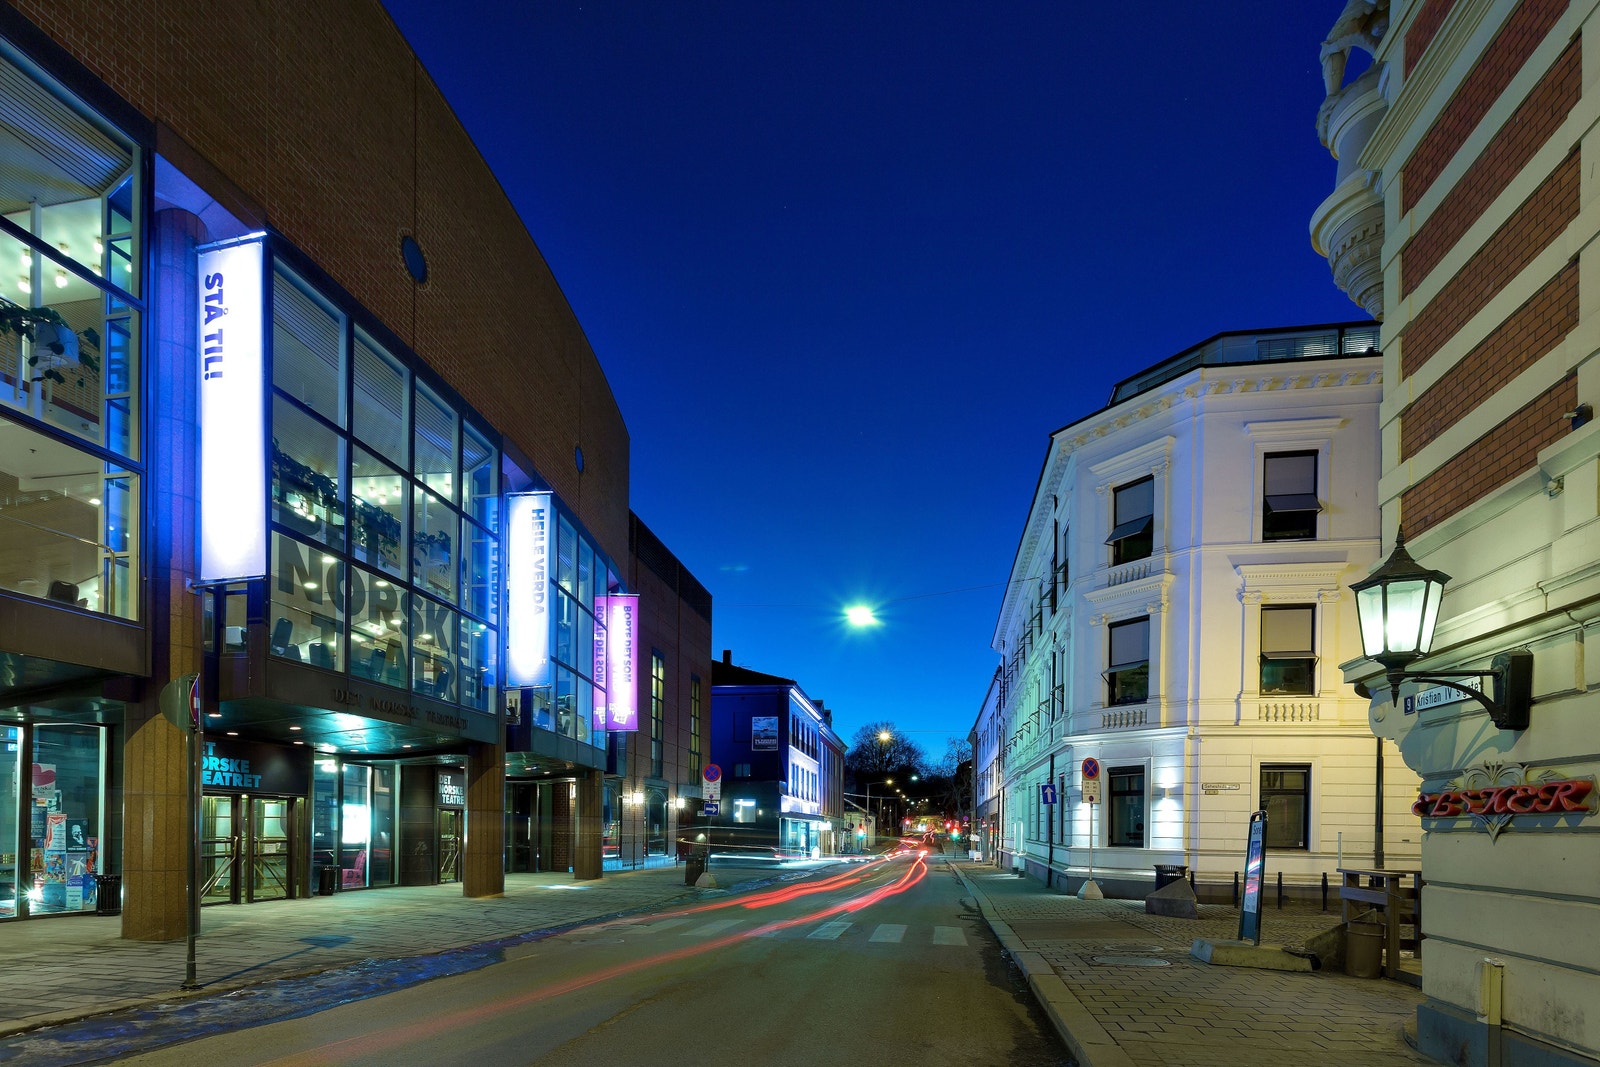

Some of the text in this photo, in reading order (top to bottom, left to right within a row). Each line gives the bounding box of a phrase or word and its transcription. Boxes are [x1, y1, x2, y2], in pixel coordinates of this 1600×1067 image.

[204, 272, 228, 381] STÅ TIL!
[531, 508, 545, 616] HEILE VERDA
[279, 533, 470, 664] NORSKE
[1406, 698, 1412, 711] 9
[1416, 691, 1442, 708] Kristian
[1444, 687, 1453, 701] IV
[202, 756, 250, 774] ORSKE
[202, 771, 262, 788] EATRET
[439, 774, 452, 785] DET
[438, 784, 464, 795] NORSKE
[441, 794, 465, 805] TEATRE
